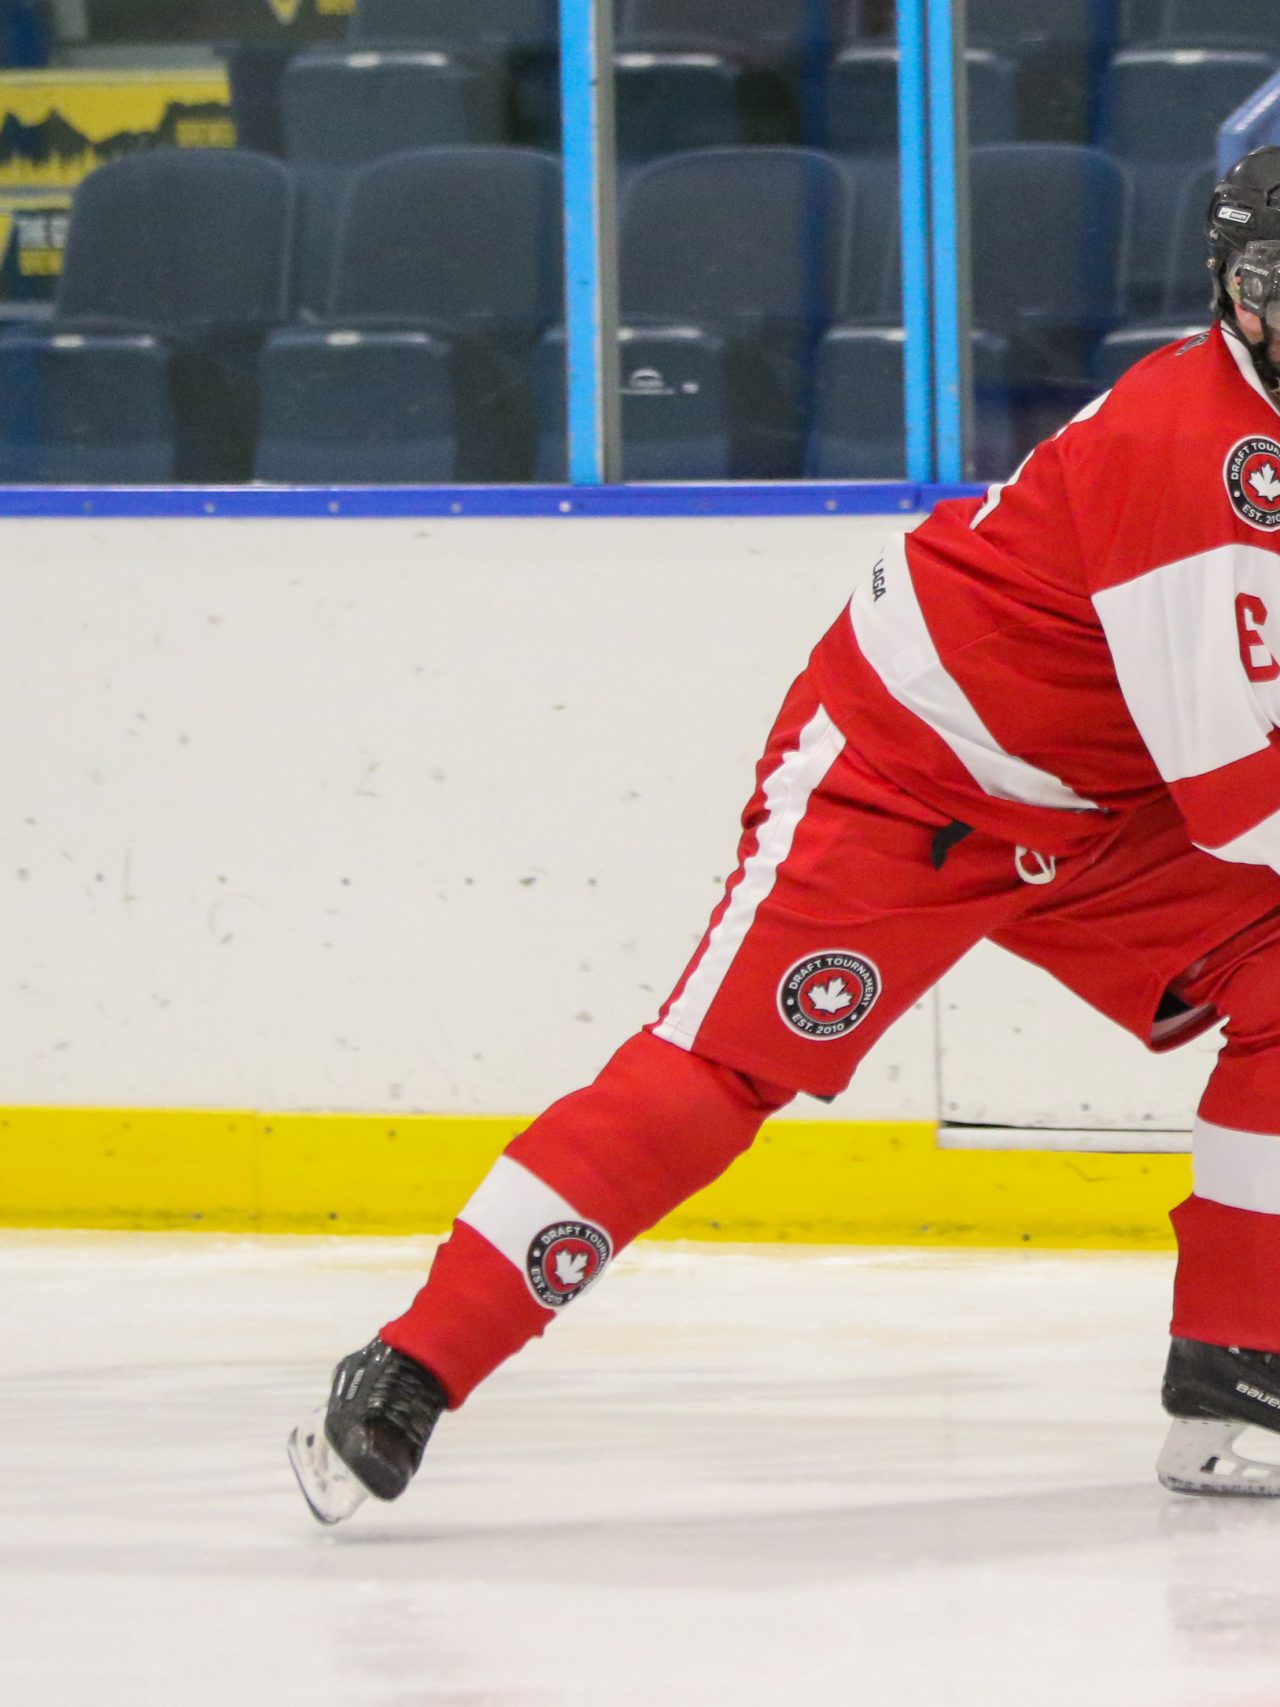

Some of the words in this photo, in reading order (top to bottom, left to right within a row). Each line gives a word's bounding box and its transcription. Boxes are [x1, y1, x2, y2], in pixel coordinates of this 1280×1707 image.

[1230, 445, 1250, 480] DRAFT
[1242, 503, 1263, 523] EST.
[788, 960, 822, 991] DRAFT
[825, 957, 874, 1008] TOURNAMENT
[791, 1013, 814, 1033] EST.
[815, 1022, 846, 1035] 2010
[541, 1225, 581, 1245] DRAFT
[530, 1267, 546, 1292] EST.
